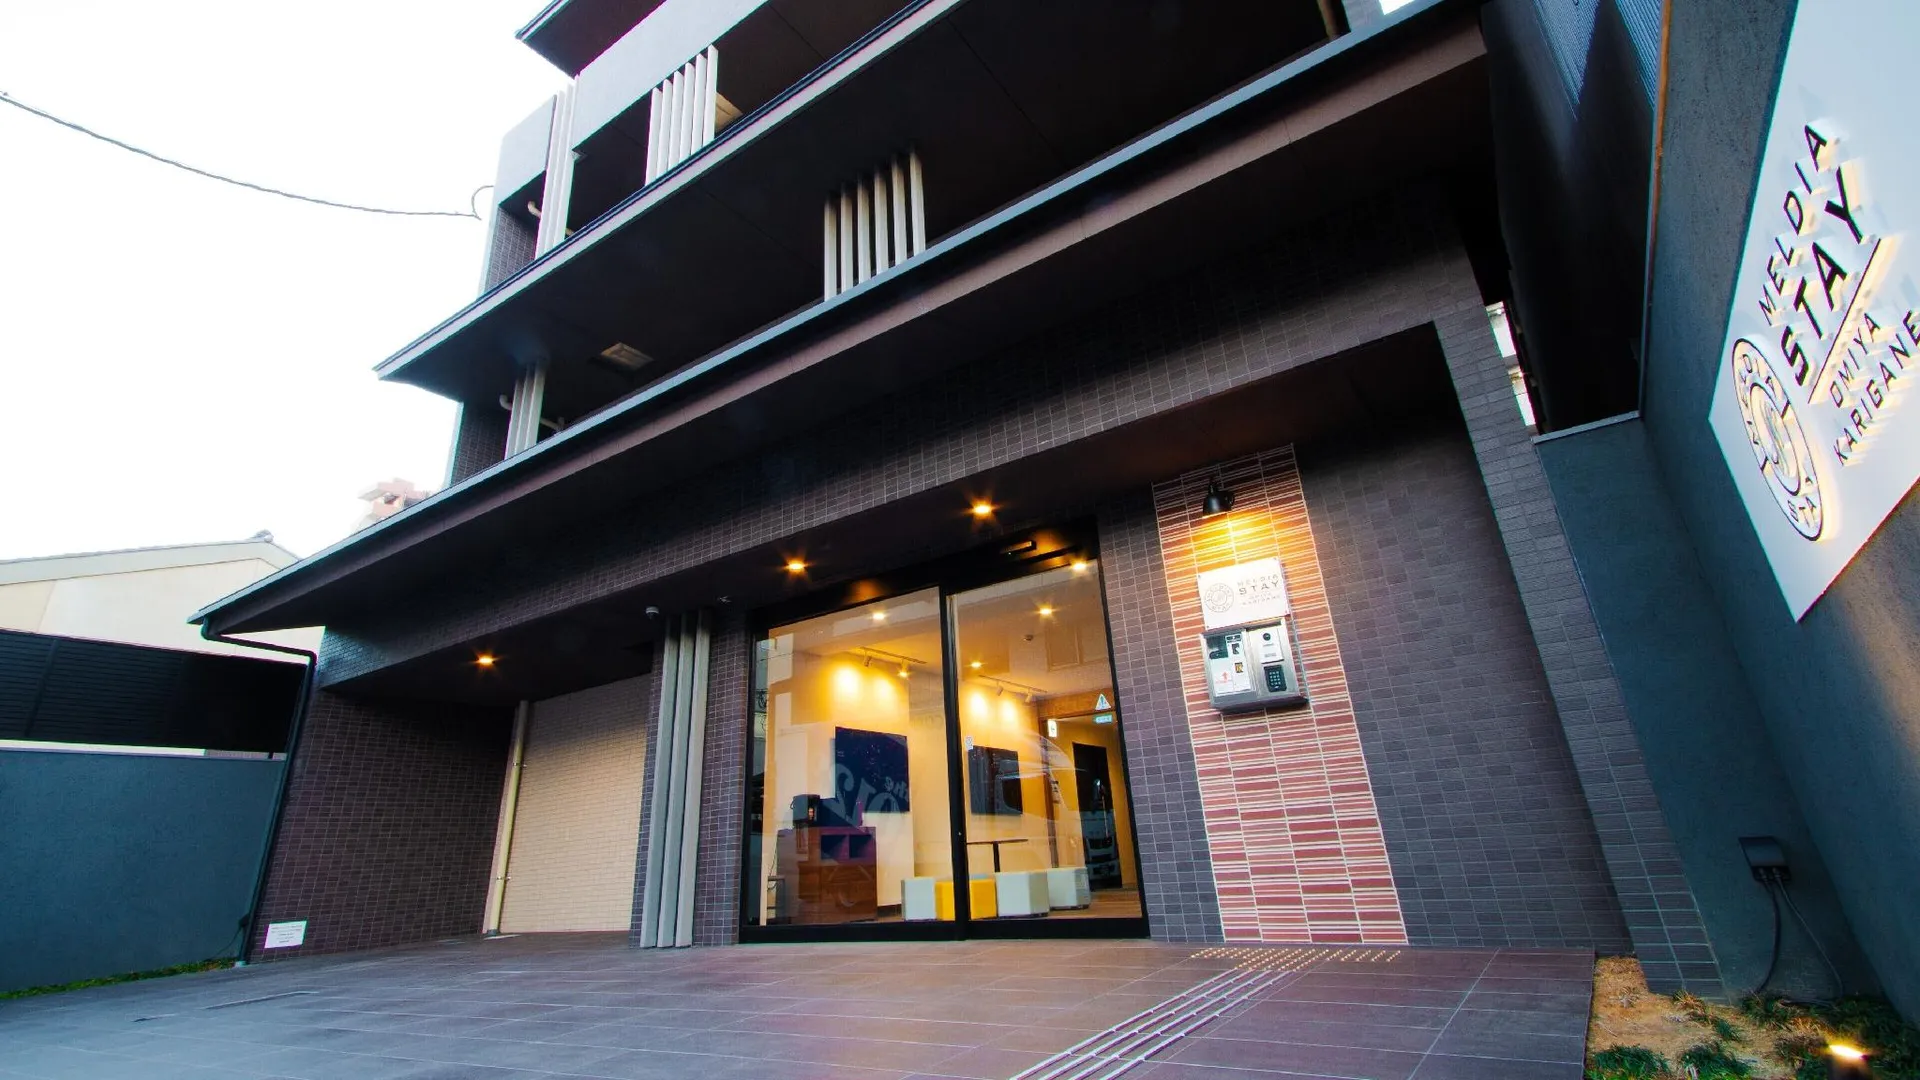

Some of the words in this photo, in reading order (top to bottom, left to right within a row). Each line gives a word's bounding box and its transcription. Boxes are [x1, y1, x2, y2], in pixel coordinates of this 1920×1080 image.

[1759, 124, 1827, 326] MELDIA
[1782, 166, 1864, 386] STAY
[1830, 313, 1881, 408] OMIYA
[1835, 311, 1920, 466] KARIGANE
[1239, 580, 1279, 595] STAY
